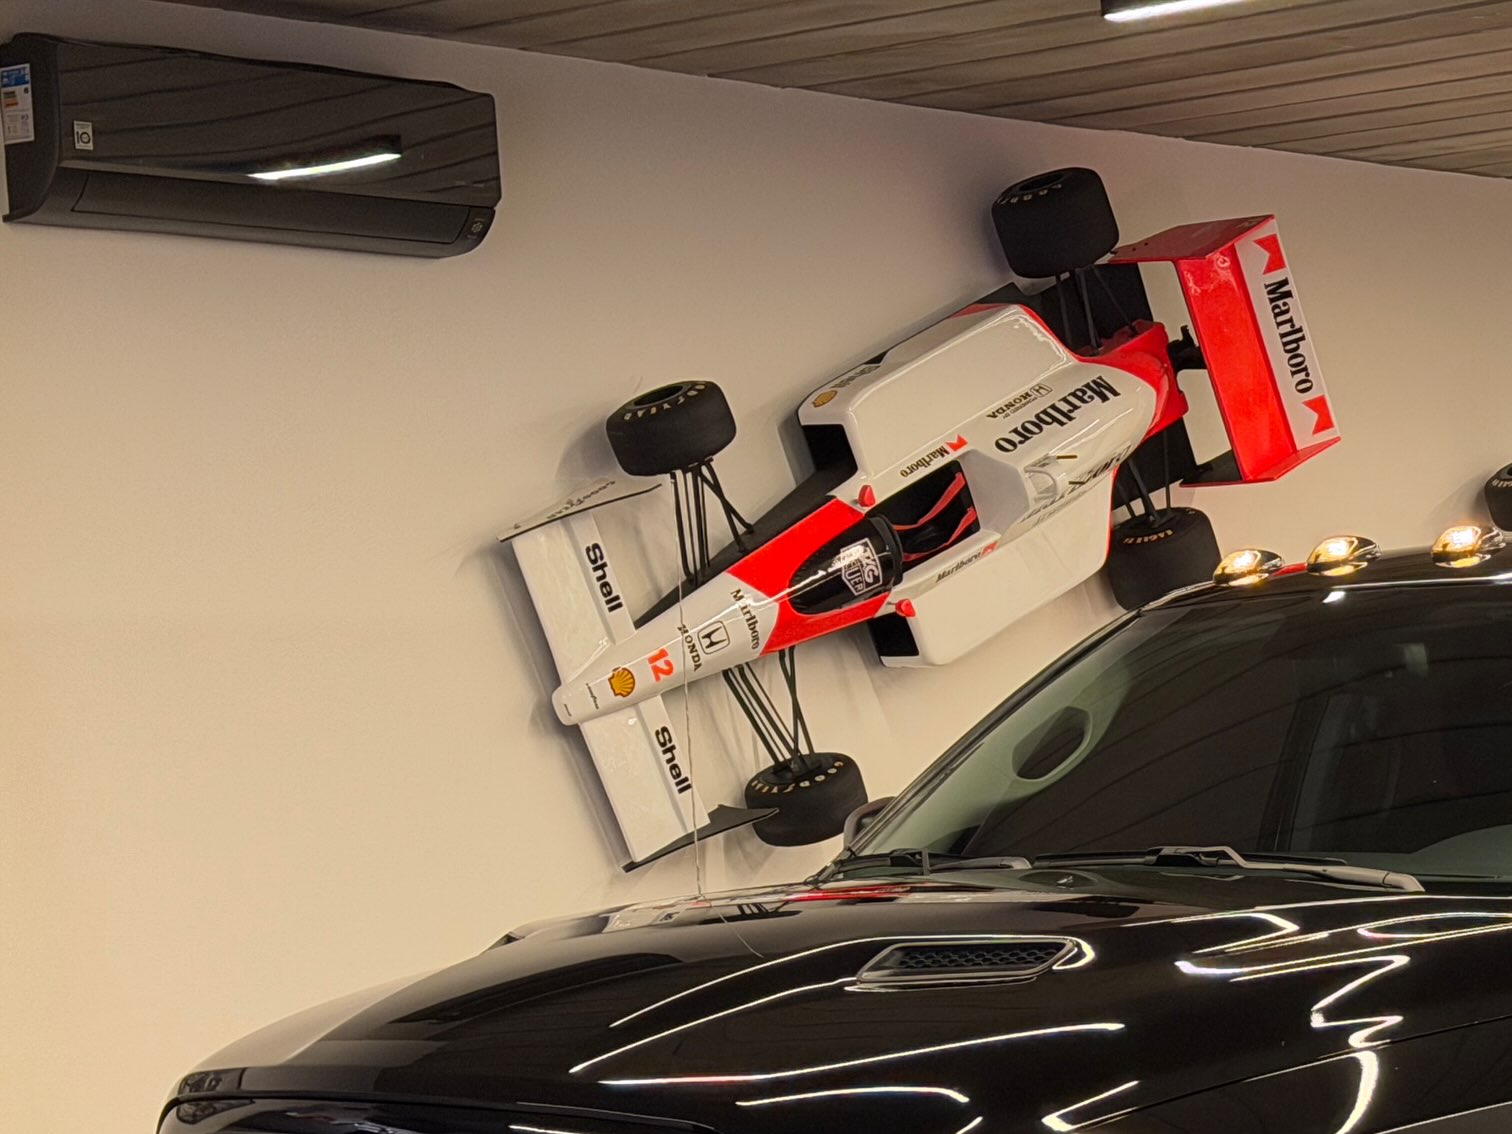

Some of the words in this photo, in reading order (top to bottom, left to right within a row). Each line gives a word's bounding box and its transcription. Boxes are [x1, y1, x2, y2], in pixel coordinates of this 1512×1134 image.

[1263, 276, 1314, 394] Marlboro
[986, 391, 1032, 419] HONDA
[995, 376, 1122, 453] Marlboro
[899, 445, 951, 478] Marlboro
[585, 542, 624, 613] Shell
[647, 647, 675, 683] 12
[654, 725, 692, 795] Shell
